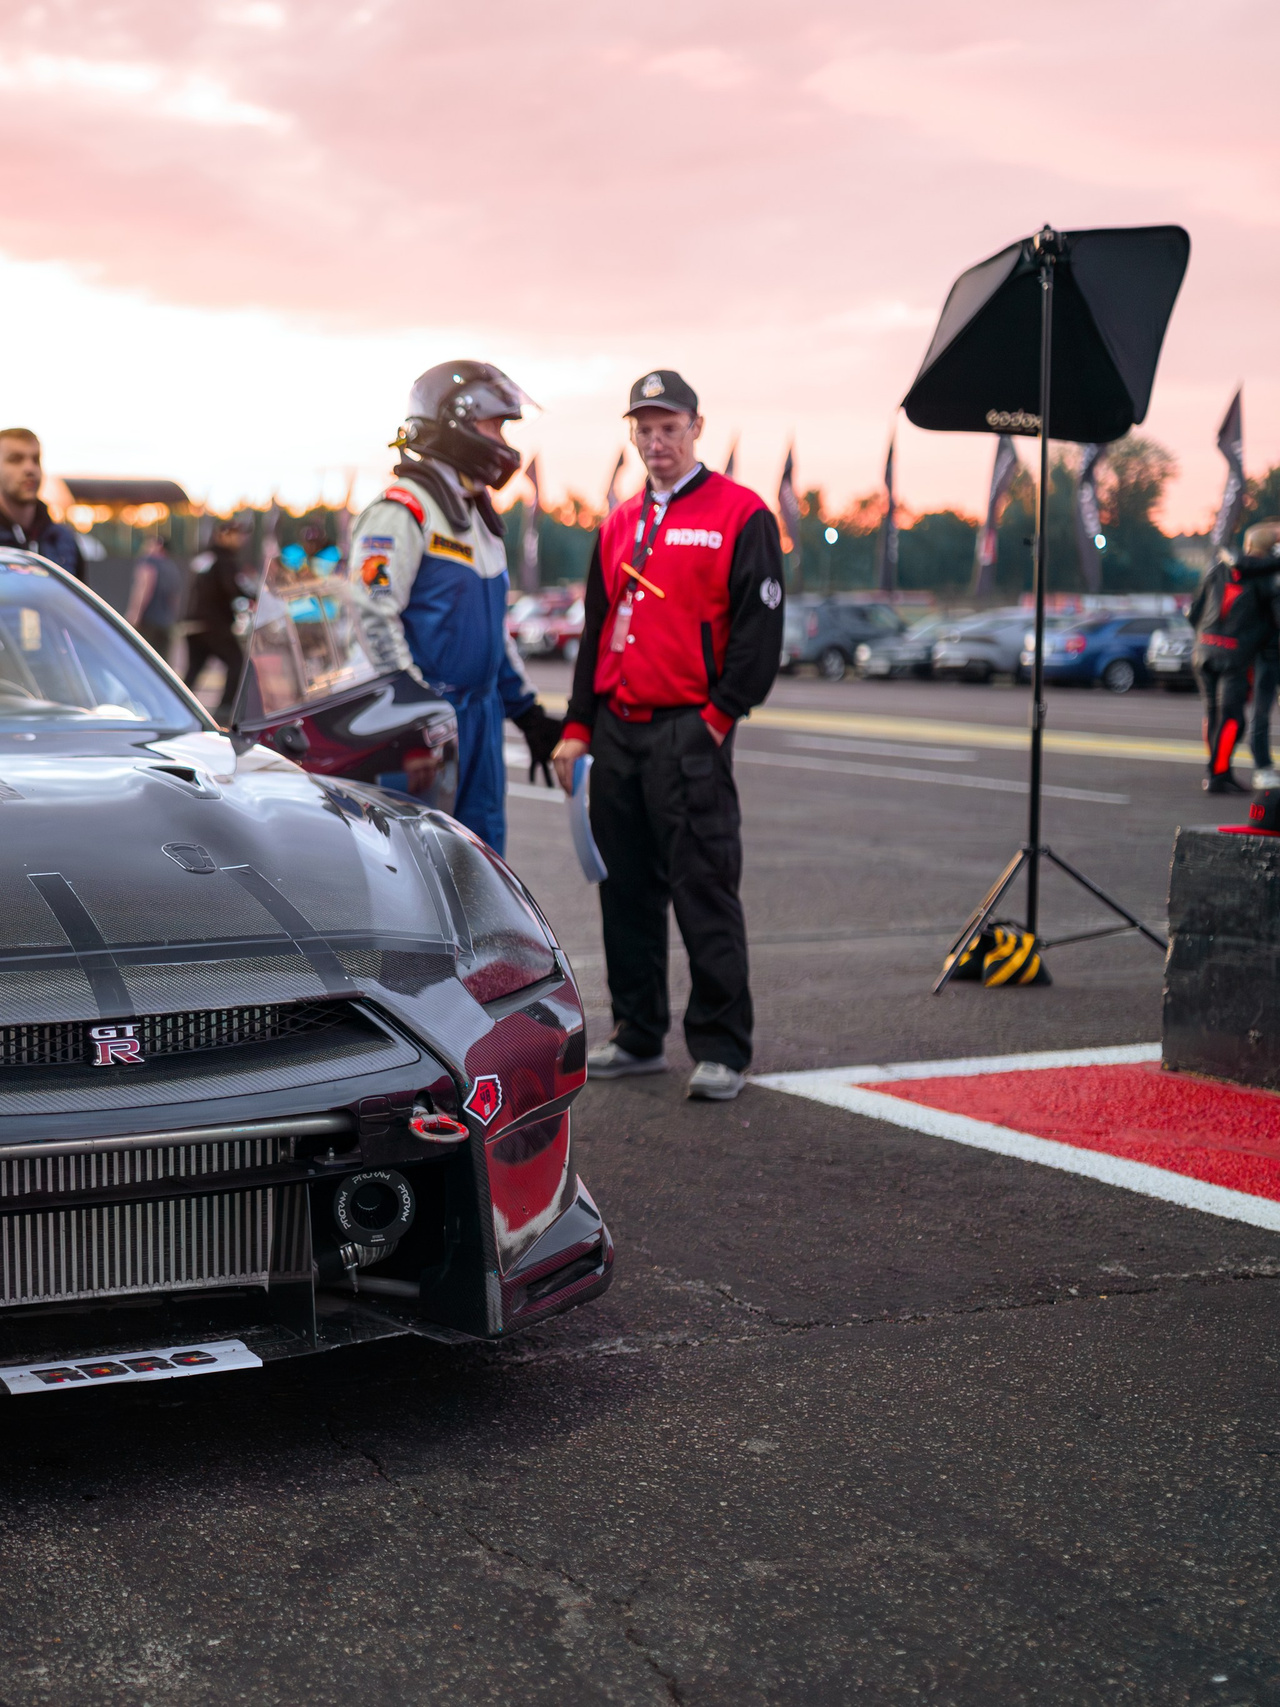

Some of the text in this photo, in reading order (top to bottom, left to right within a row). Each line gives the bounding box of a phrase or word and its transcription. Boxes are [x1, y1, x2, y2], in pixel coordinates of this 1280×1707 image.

[91, 1023, 142, 1040] GT
[93, 1038, 145, 1067] R
[30, 1350, 218, 1384] RDRC
